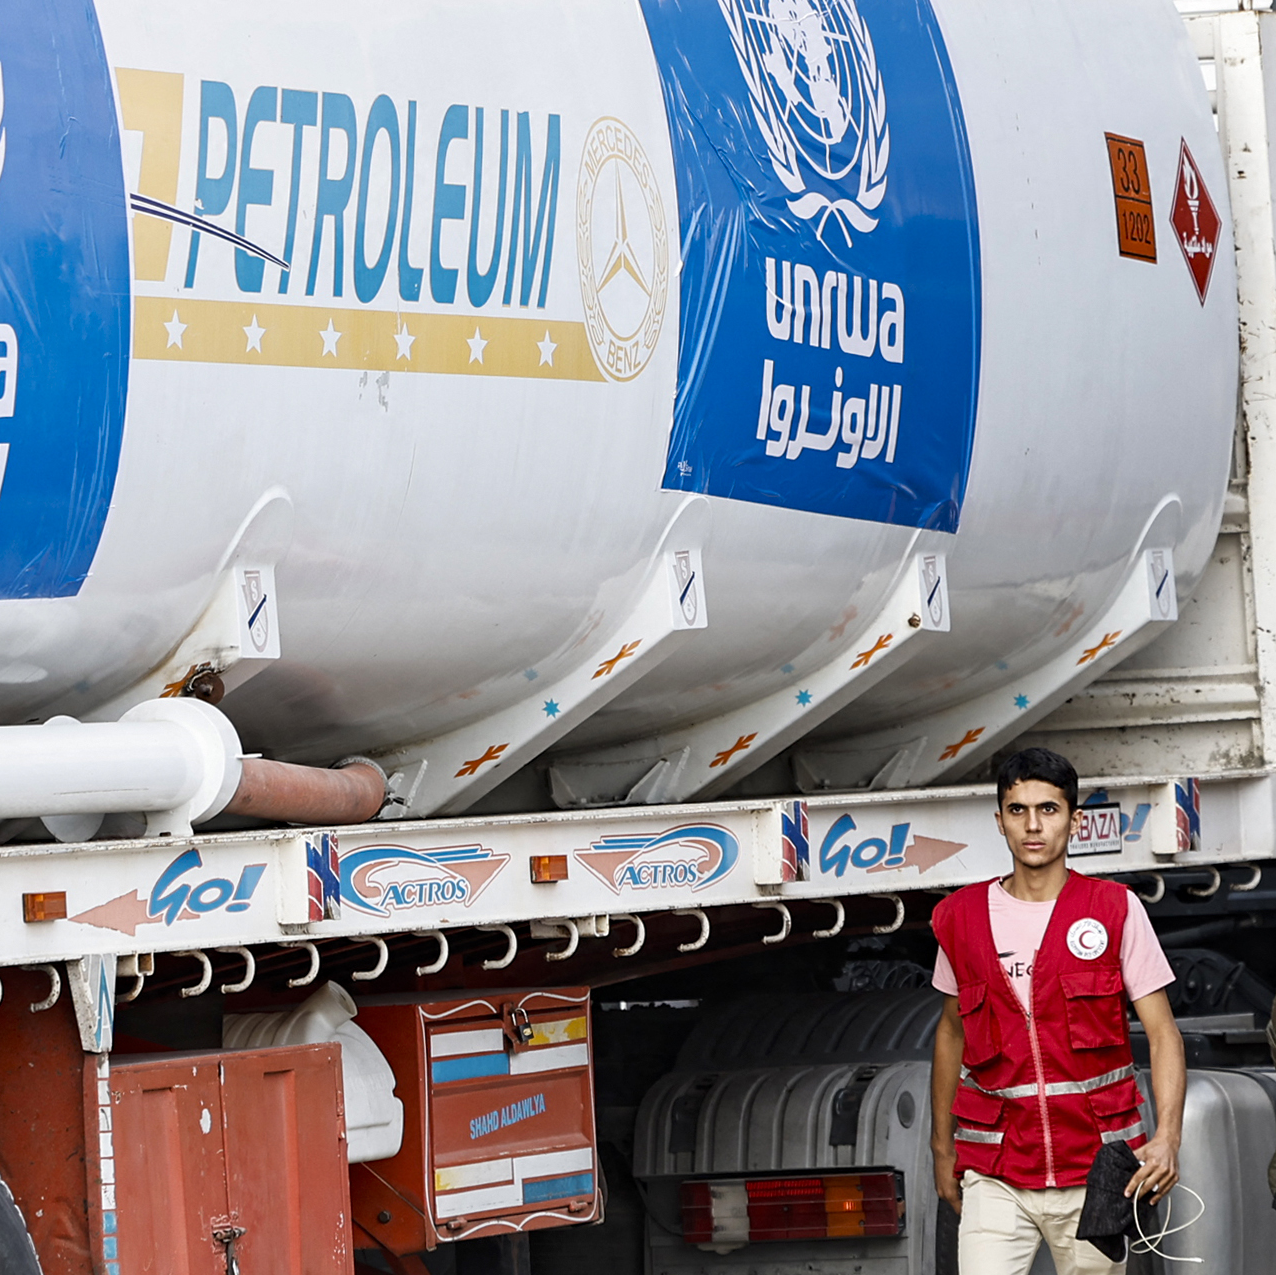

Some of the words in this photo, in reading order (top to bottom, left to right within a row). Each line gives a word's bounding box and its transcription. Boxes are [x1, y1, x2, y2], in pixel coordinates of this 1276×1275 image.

[584, 125, 650, 190] MERCEDES
[1117, 147, 1142, 196] 33
[182, 78, 562, 311] PETROLEUM
[1121, 210, 1152, 246] 1202
[765, 256, 905, 364] unrwa
[605, 339, 642, 375] BENZ
[379, 878, 467, 908] ACTROS
[617, 861, 699, 887] ACTROS
[469, 1109, 500, 1140] SHAHD
[500, 1092, 547, 1128] ALDAWLYA
